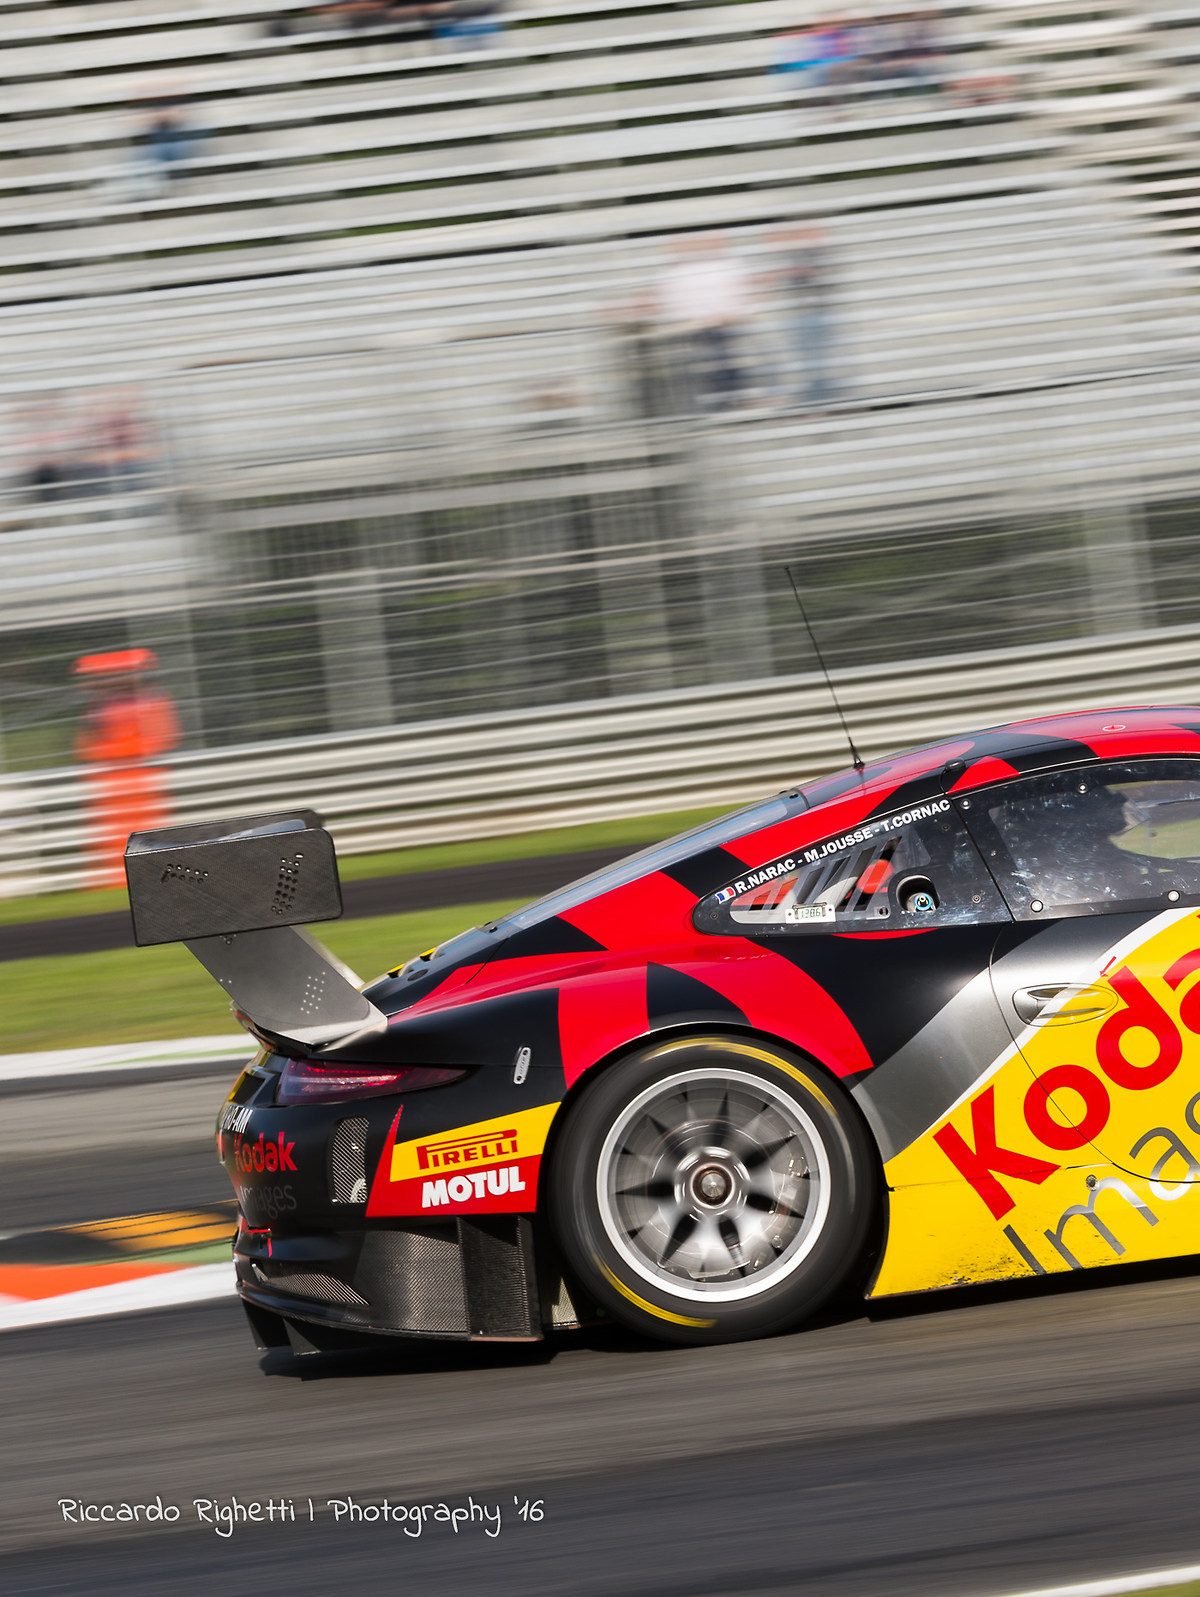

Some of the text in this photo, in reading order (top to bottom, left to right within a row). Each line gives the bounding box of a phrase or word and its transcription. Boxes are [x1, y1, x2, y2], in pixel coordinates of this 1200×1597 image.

[735, 858, 796, 893] R.NARAC
[804, 827, 874, 864] M.JOUSSE
[881, 799, 951, 832] T.CORNAC
[234, 1132, 298, 1173] Kodak
[416, 1129, 518, 1170] PIRELLI
[422, 1166, 525, 1208] MOTUL
